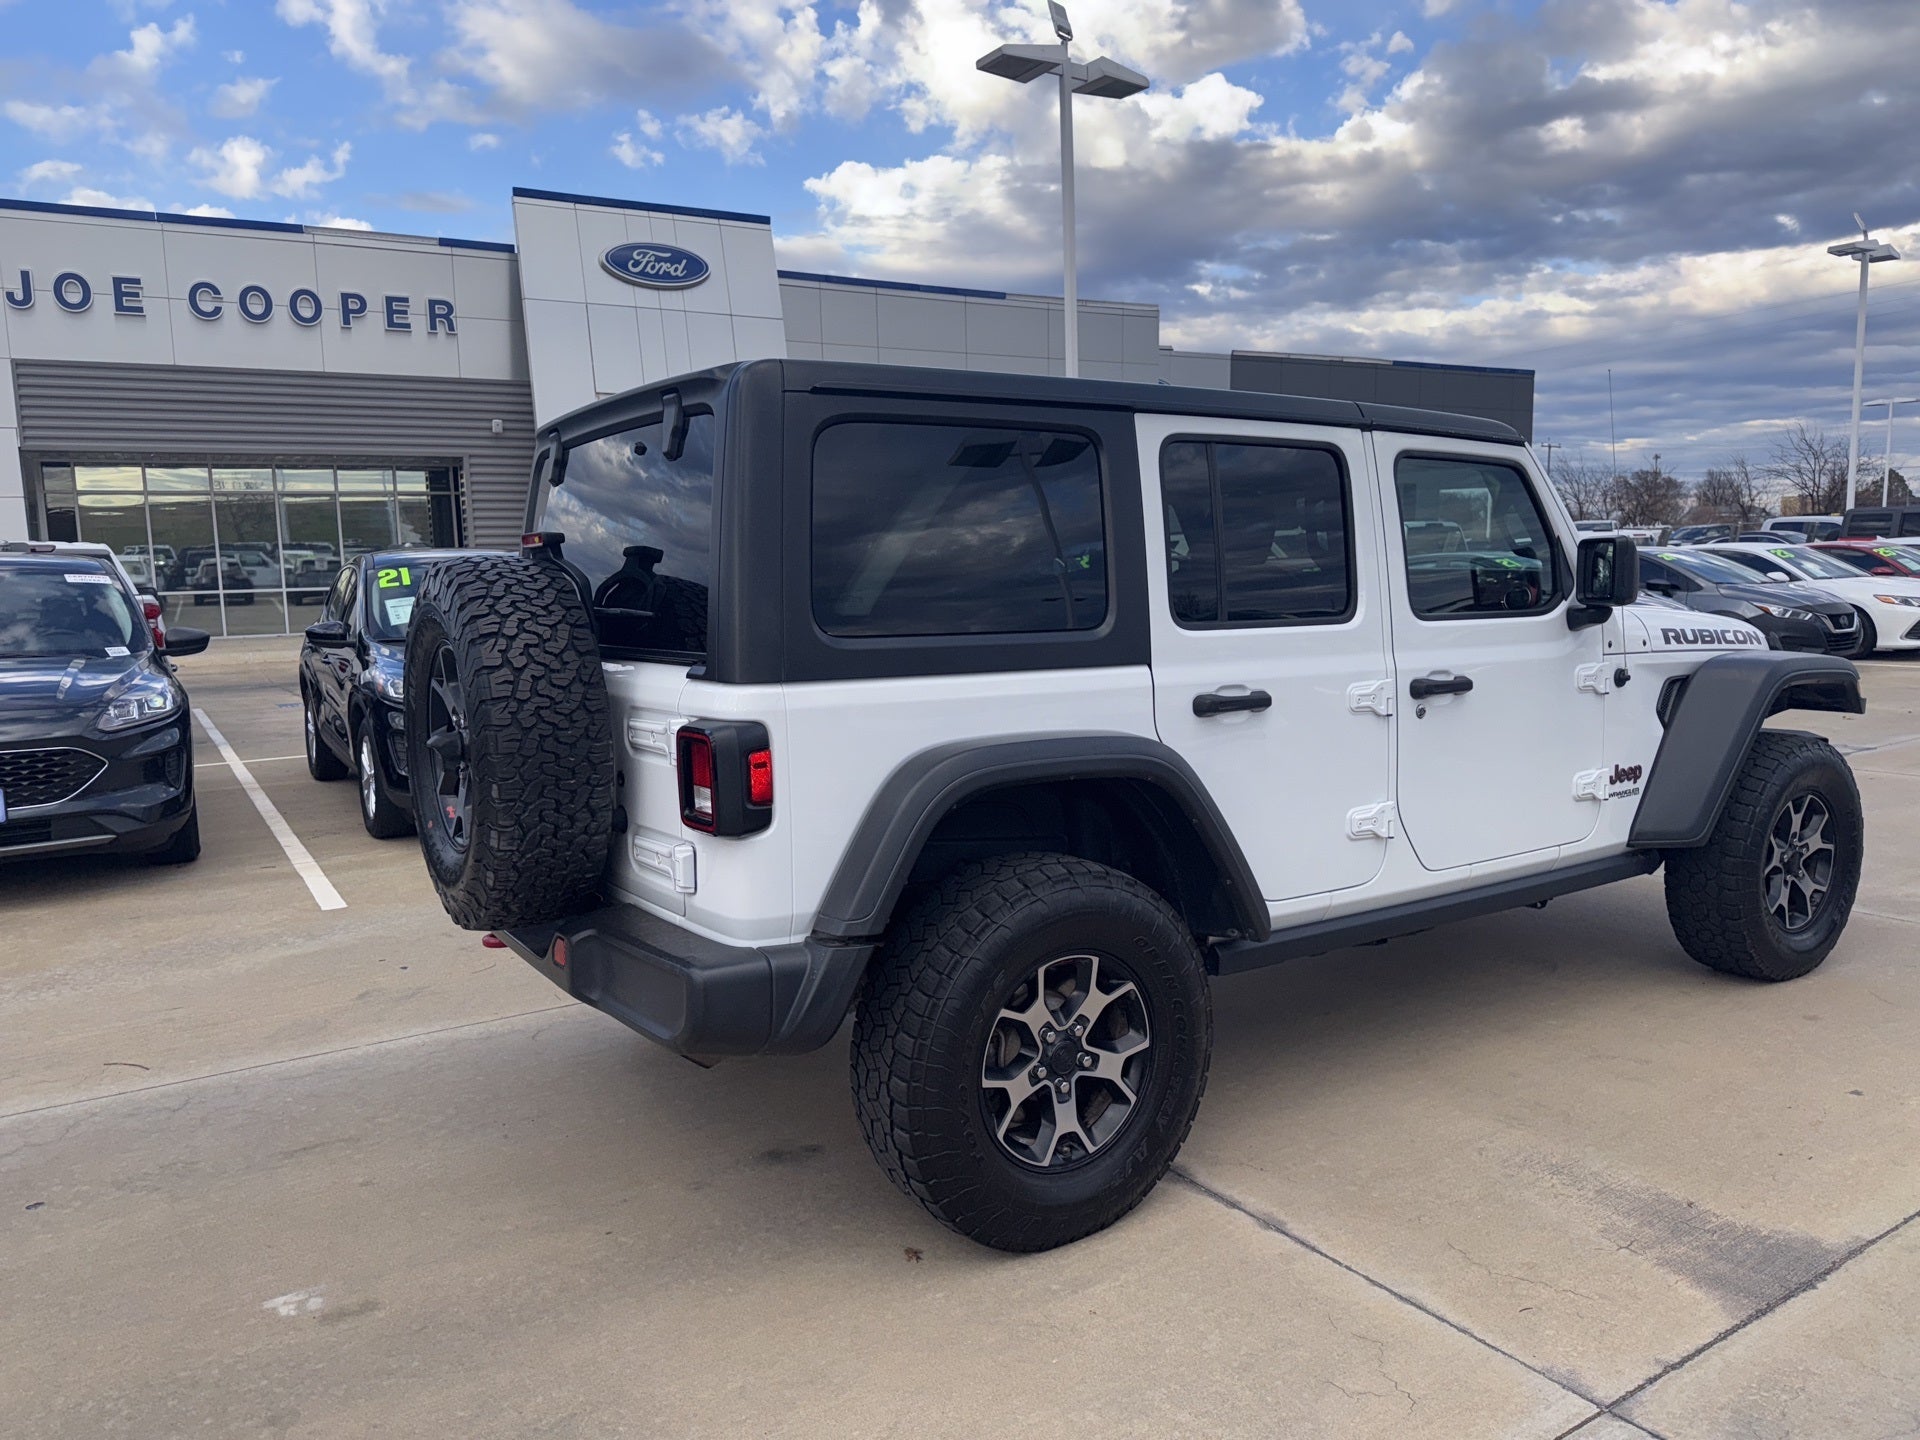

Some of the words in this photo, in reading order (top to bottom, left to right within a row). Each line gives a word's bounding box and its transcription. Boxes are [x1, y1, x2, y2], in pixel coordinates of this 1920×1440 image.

[628, 249, 687, 277] Ford
[4, 267, 146, 316] JOE
[187, 280, 458, 335] COOPER
[377, 567, 412, 589] 21
[1660, 627, 1763, 645] RUBICON
[1609, 763, 1643, 785] Jeep
